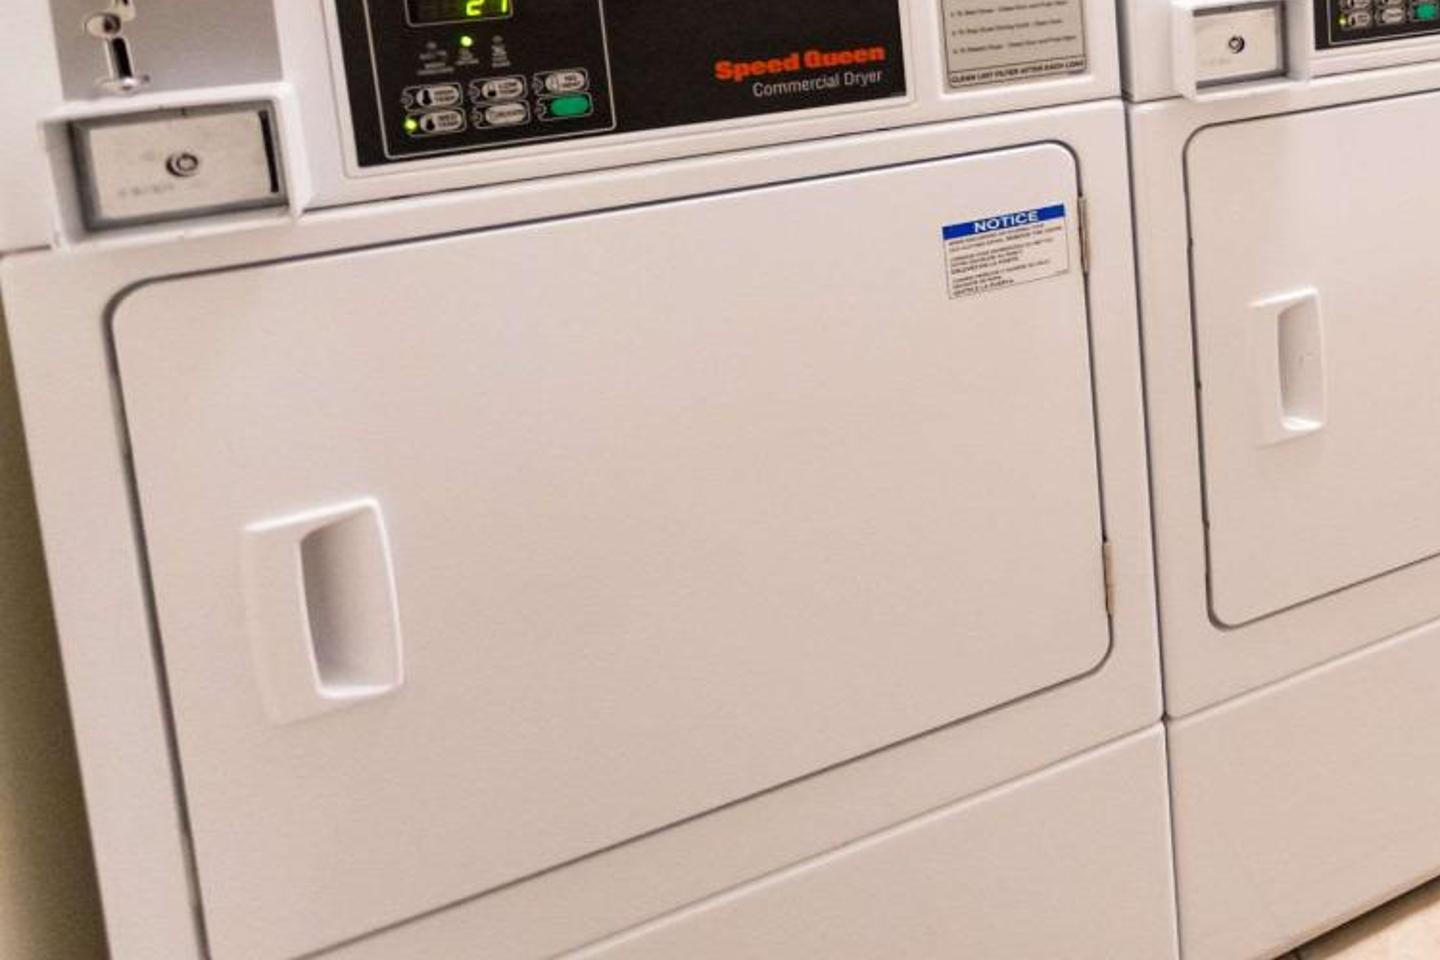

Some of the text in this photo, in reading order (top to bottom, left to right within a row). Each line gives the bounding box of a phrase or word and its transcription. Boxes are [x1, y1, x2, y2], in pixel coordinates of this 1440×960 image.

[714, 46, 886, 83] Speed Queen
[752, 70, 883, 98] Commercial Dryer
[973, 210, 1040, 233] NOTICE
